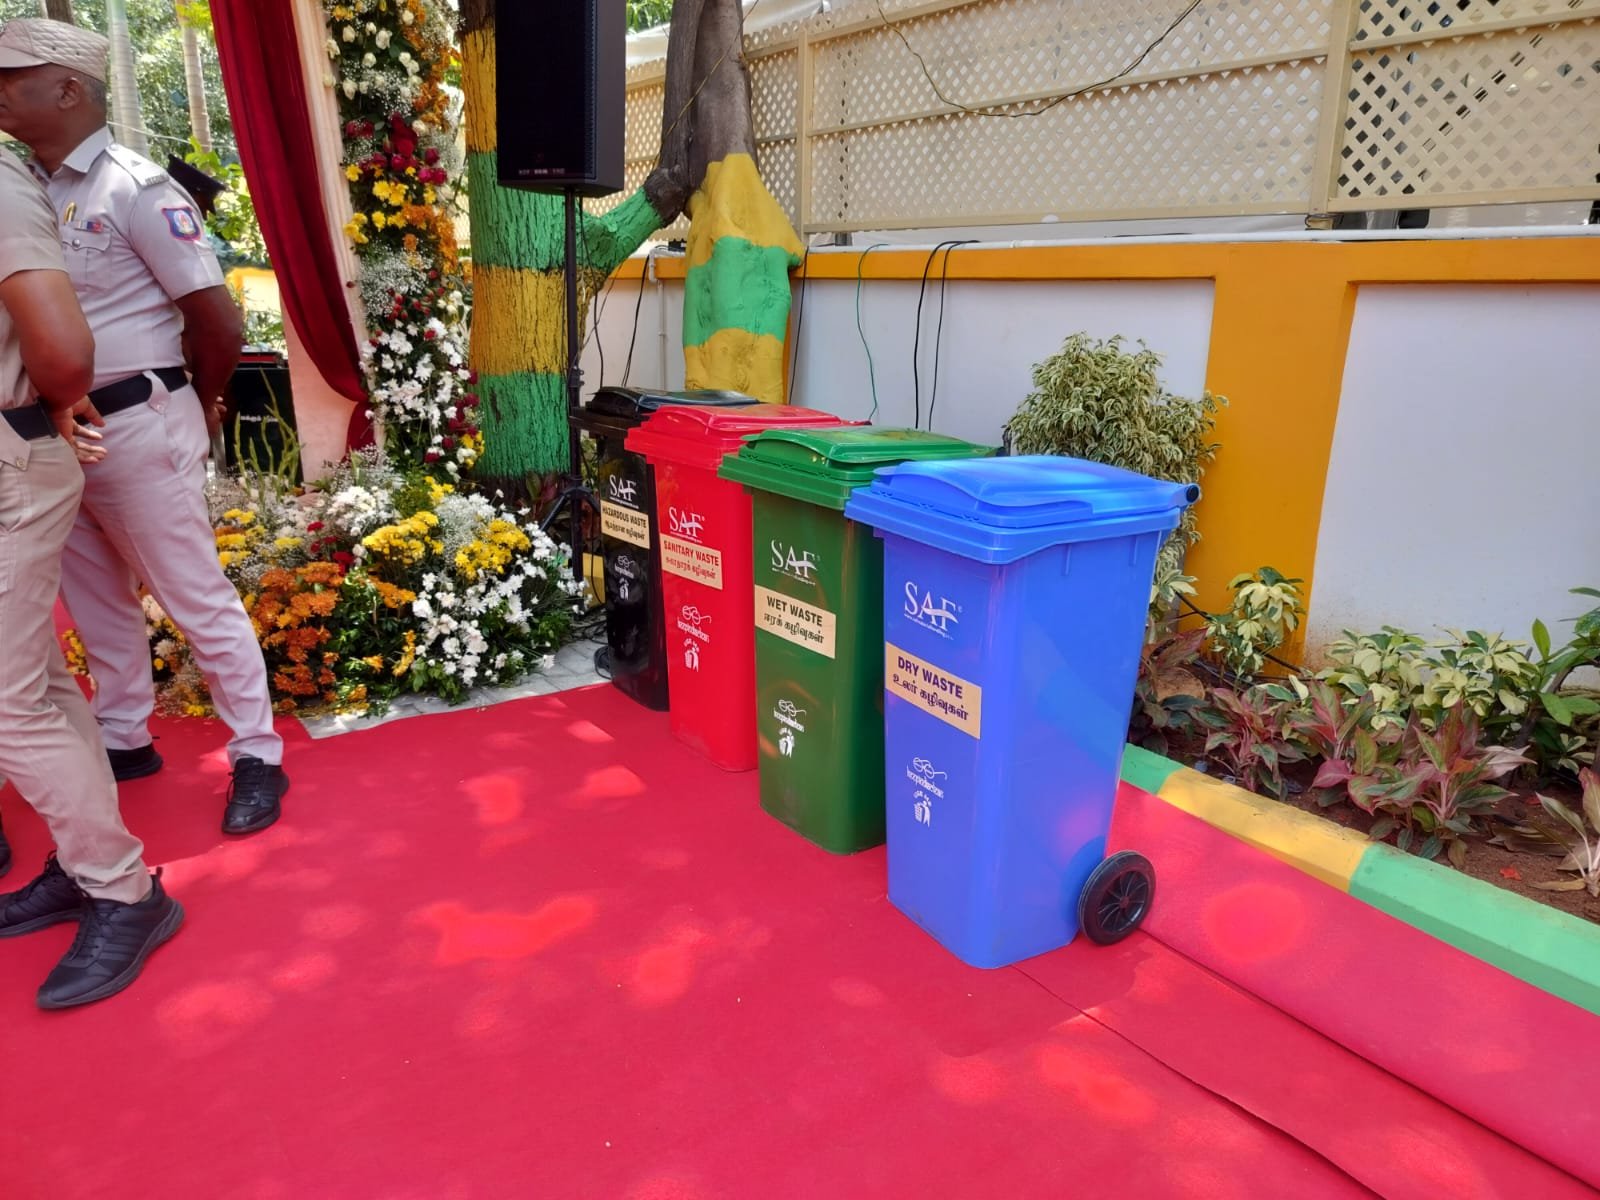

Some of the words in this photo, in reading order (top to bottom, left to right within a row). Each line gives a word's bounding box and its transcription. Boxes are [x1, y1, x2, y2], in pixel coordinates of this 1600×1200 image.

[609, 474, 637, 502] SAF
[602, 507, 629, 523] HAZARDOUS
[630, 514, 647, 529] WASTE
[669, 506, 704, 538] SAF
[663, 540, 694, 559] SANITARY
[695, 550, 720, 567] WASTE
[771, 539, 818, 579] SAF
[766, 595, 788, 613] WET
[790, 604, 823, 627] WASTE
[904, 581, 959, 631] SAF
[784, 621, 825, 644] கழிவுகள்
[897, 656, 920, 678] DRY
[922, 668, 963, 699] WASTE
[892, 673, 918, 694] உலர்
[919, 692, 969, 721] கழிவுகள்
